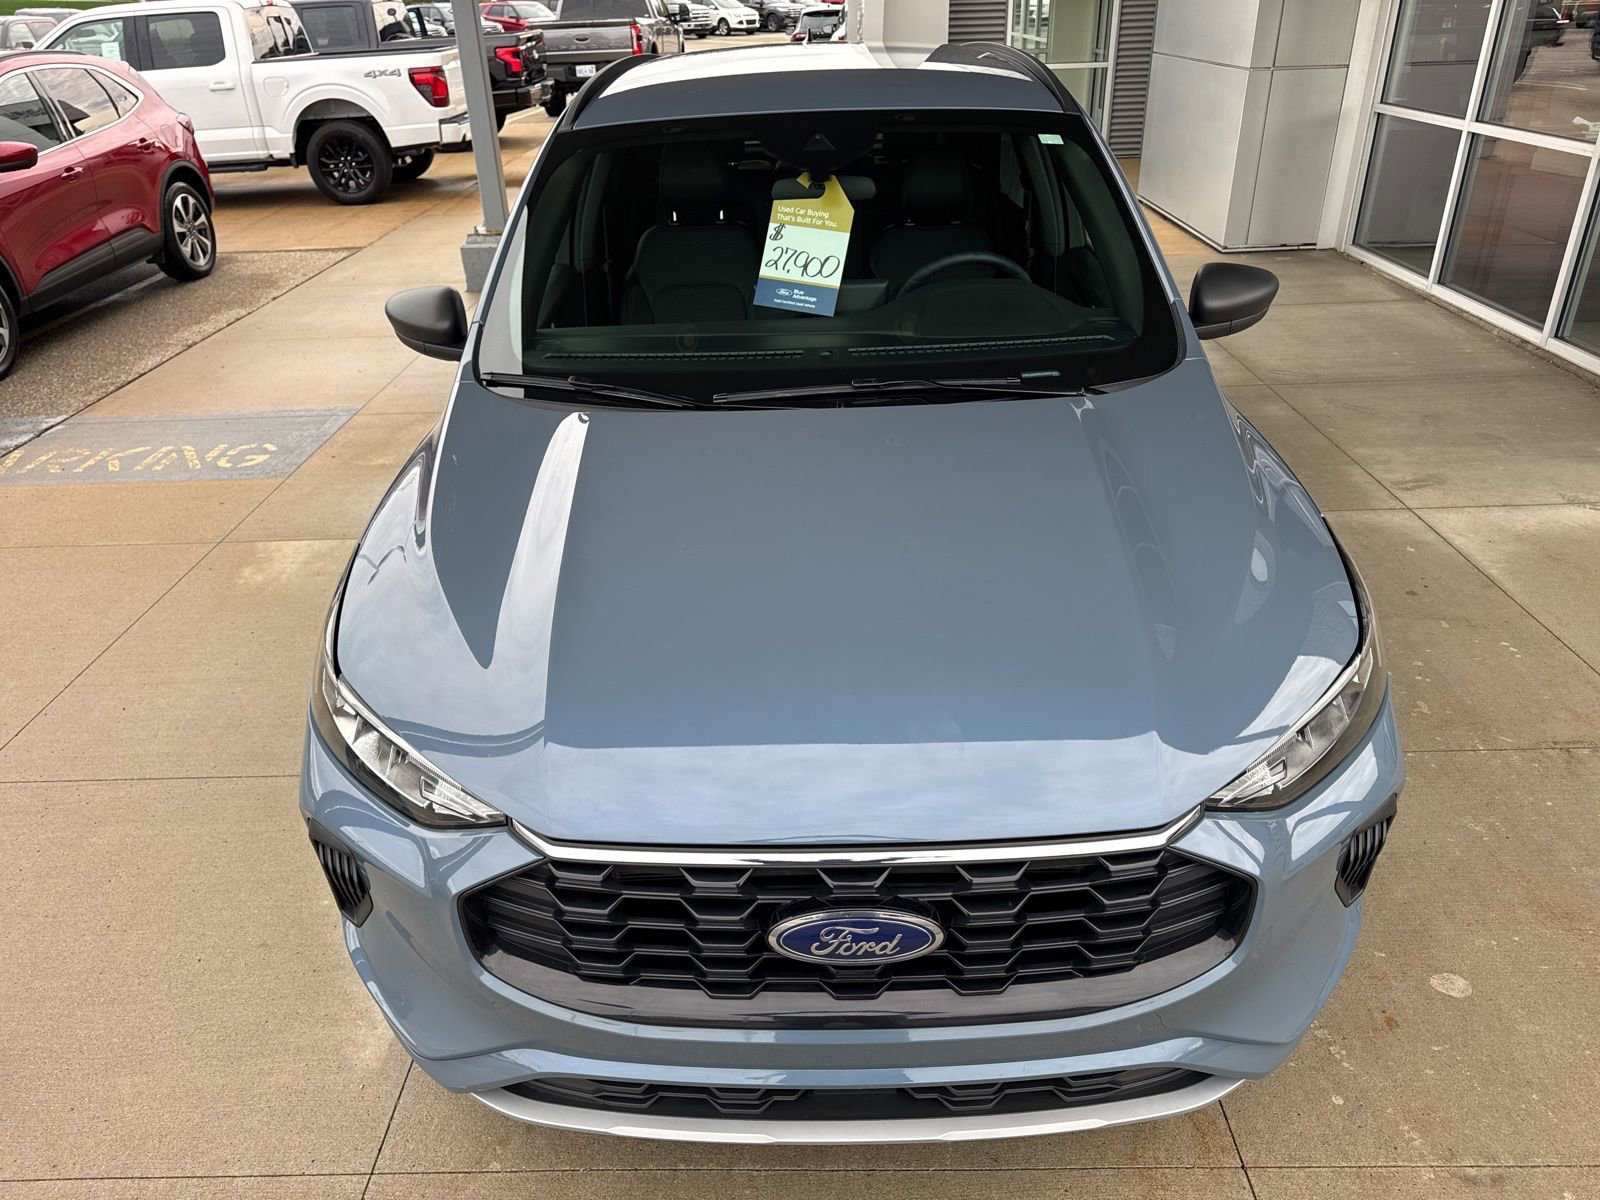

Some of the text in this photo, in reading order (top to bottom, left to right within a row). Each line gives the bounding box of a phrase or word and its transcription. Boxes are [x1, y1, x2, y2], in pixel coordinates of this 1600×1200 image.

[777, 205, 830, 219] Used Car Buying
[776, 213, 796, 222] That's
[796, 216, 811, 224] Built
[812, 218, 824, 226] For
[769, 223, 786, 241] $
[792, 294, 817, 303] Advantage
[811, 926, 903, 956] Ford
